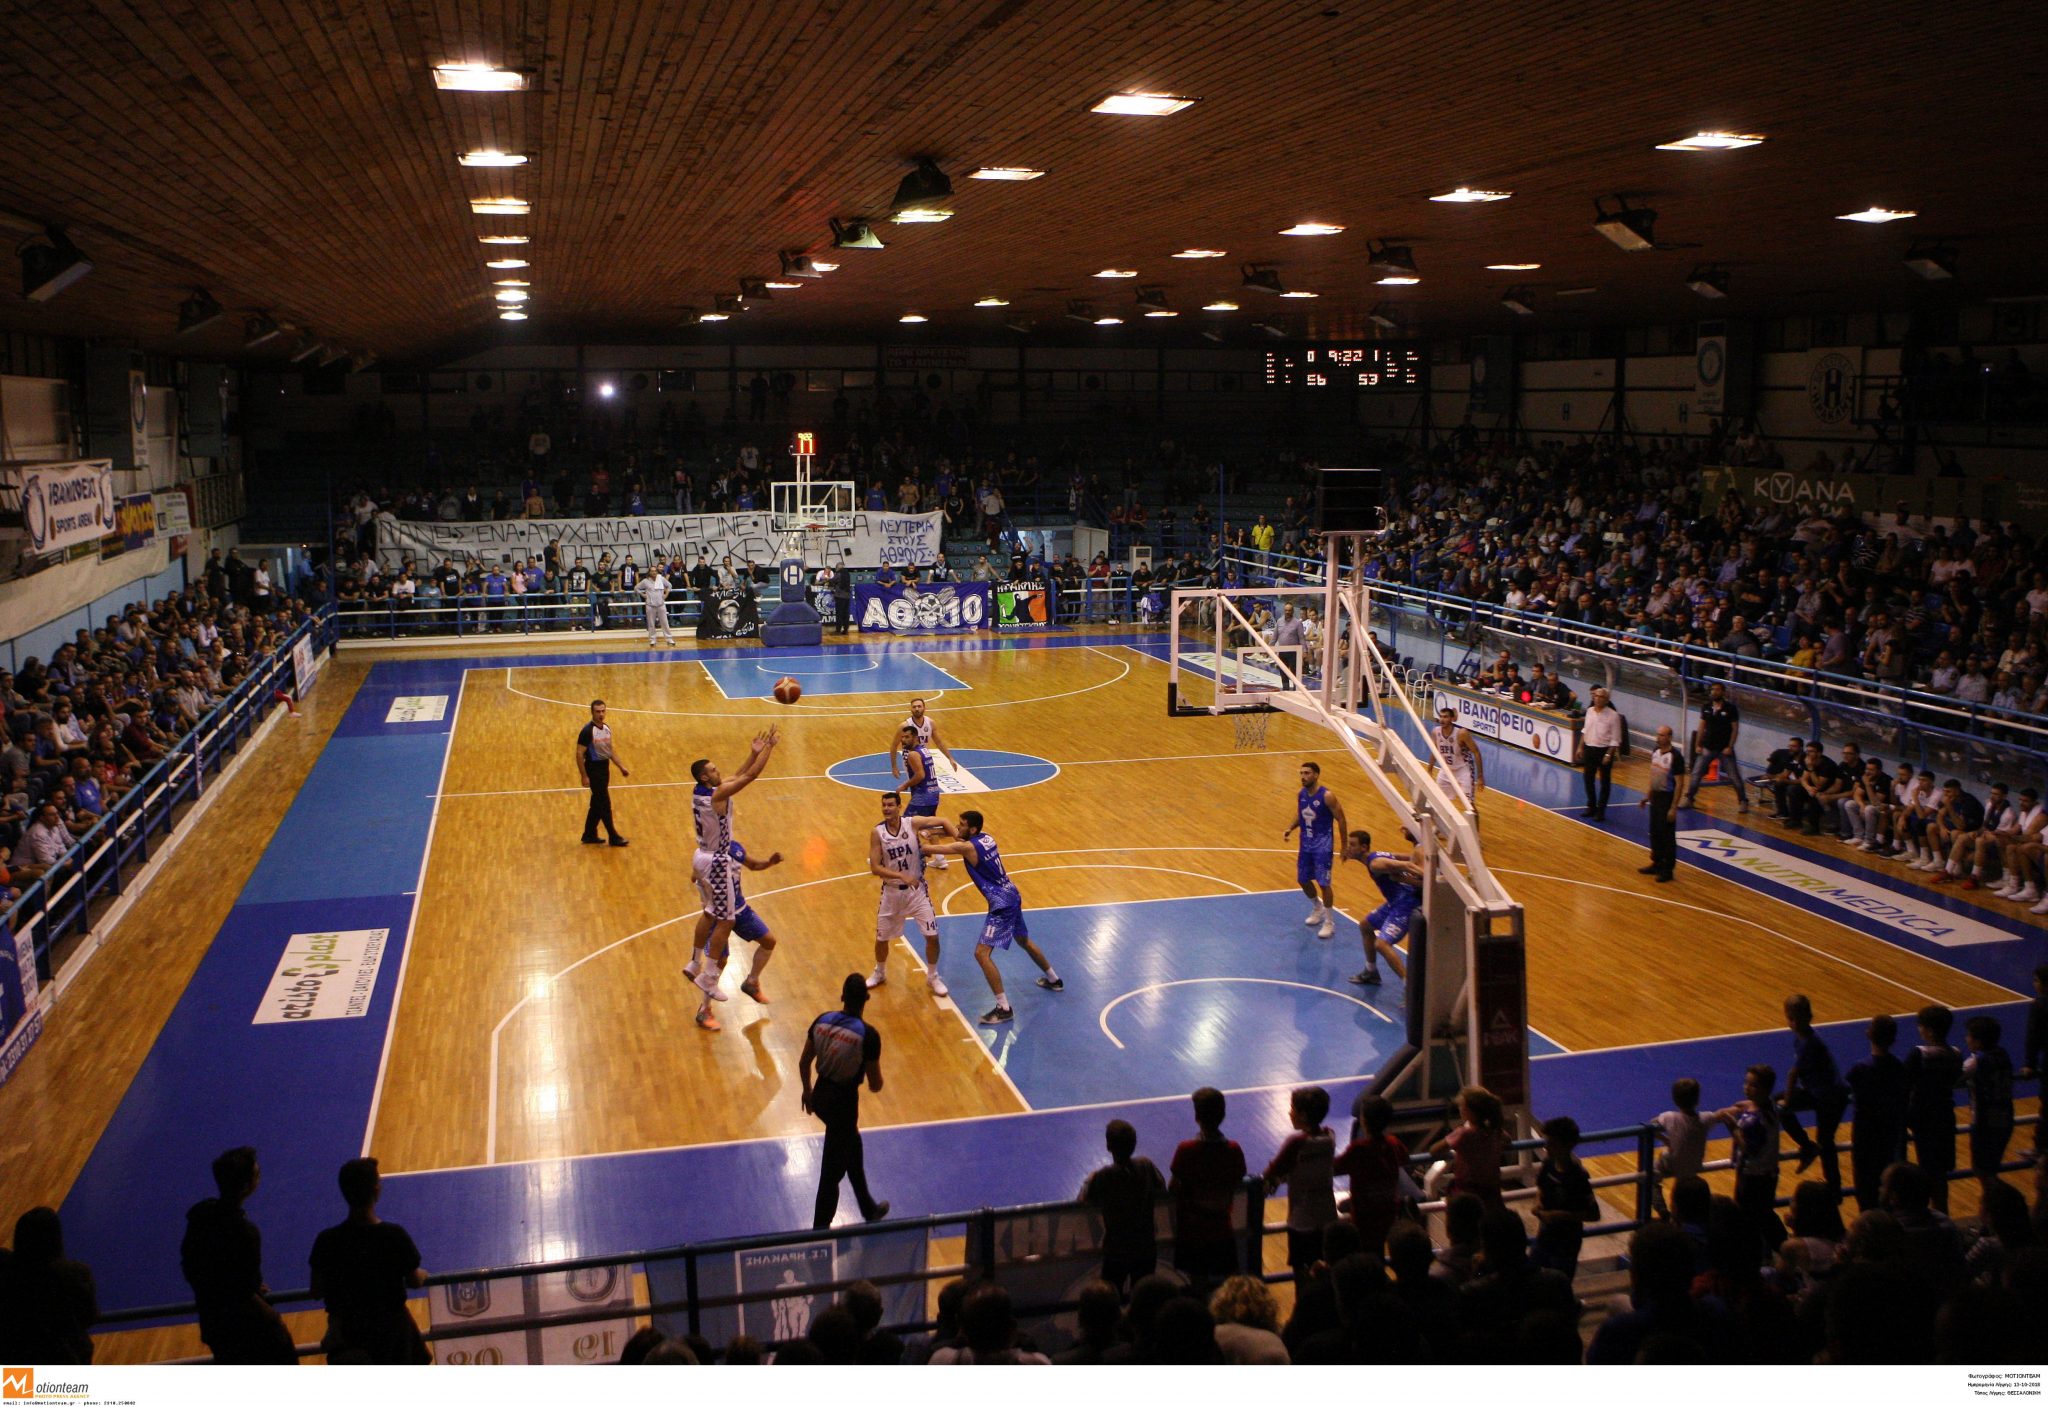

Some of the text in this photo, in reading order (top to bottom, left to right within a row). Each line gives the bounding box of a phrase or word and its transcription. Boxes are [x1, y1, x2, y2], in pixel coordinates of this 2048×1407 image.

[1328, 351, 1363, 362] 9:22
[1359, 373, 1379, 386] 53
[1754, 473, 1855, 503] KYANA
[56, 512, 94, 534] SPORTS ARENA
[527, 521, 633, 543] ΑΤΥΧΗΜΑ
[638, 519, 676, 541] ΠΟΥ
[683, 514, 755, 539] ΕΓΙΝΕ
[881, 519, 935, 534] ΛΕΥΤΕΡΙΑ
[888, 535, 926, 546] ΣΤΟΥΣ
[1472, 720, 1496, 734] SPORTS
[887, 844, 913, 861] ΗΡΑ
[897, 860, 909, 872] 14
[1730, 857, 1956, 937] NUTRIMEDICA
[926, 921, 937, 931] 14
